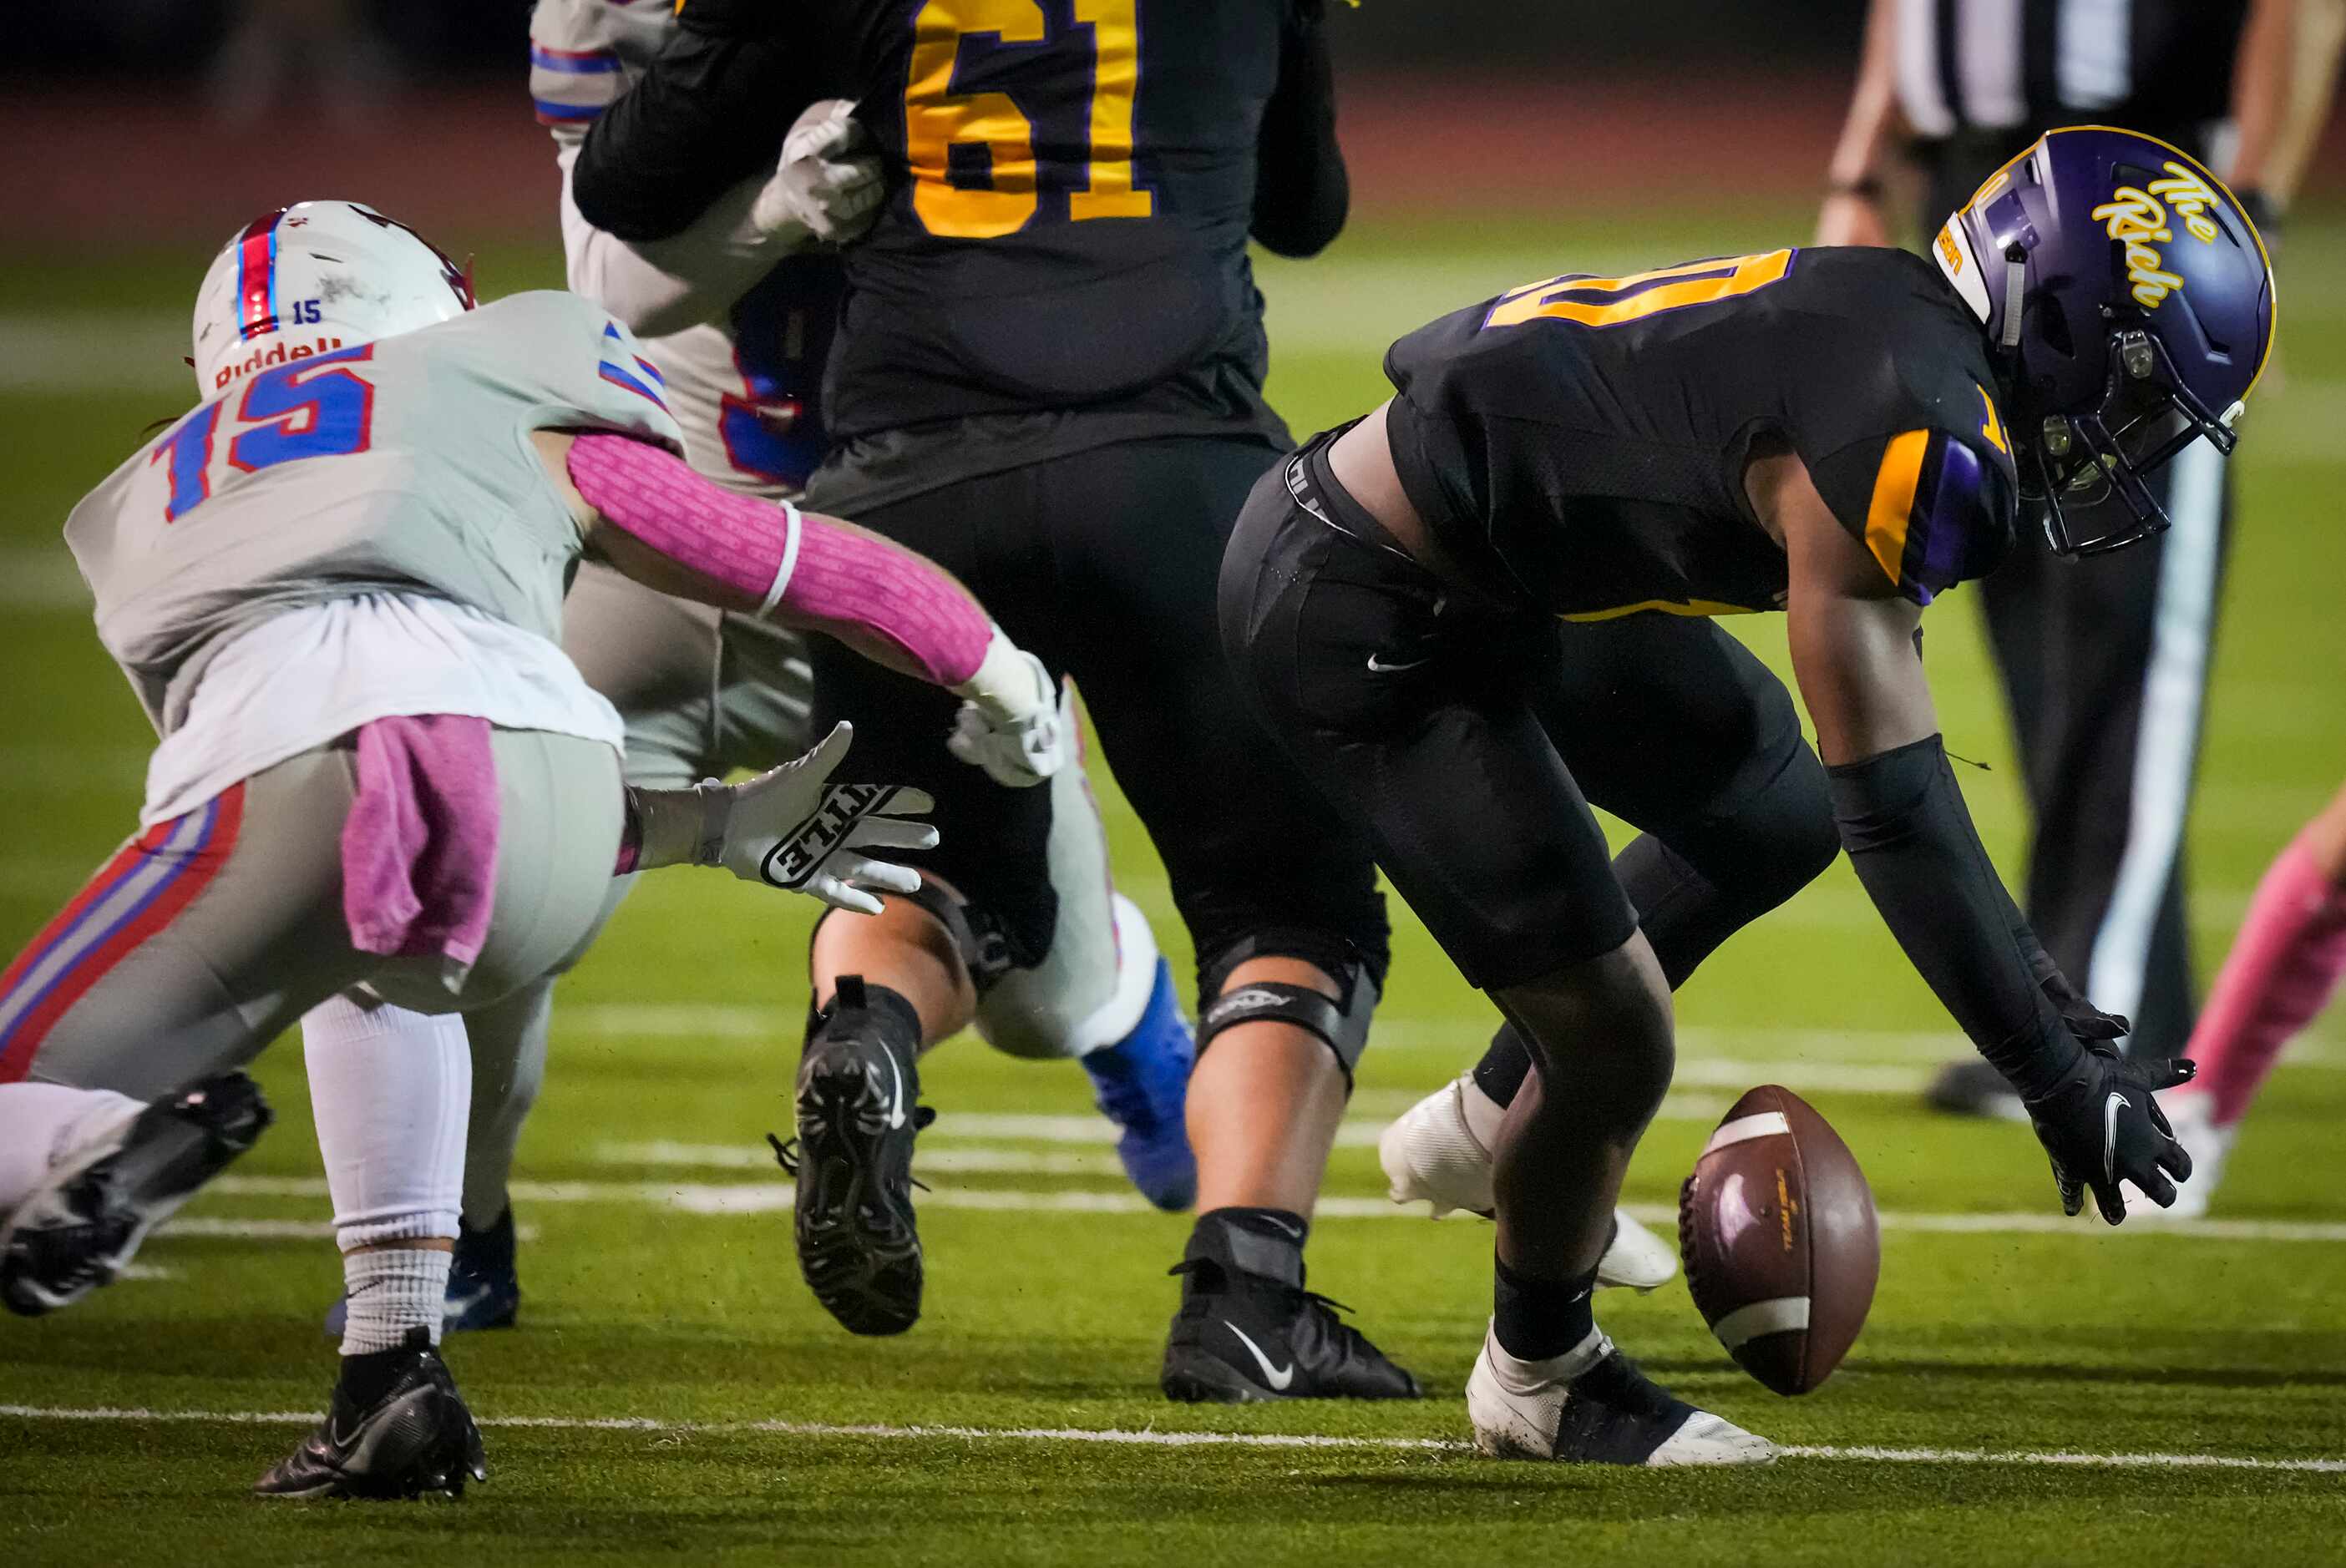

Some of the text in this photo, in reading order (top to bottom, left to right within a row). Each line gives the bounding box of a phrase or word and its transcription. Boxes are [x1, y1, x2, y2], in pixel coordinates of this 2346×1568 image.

[902, 0, 1154, 240] 61
[2091, 186, 2185, 309] Rich
[2148, 160, 2219, 245] The
[292, 299, 322, 325] 15
[215, 336, 342, 390] Riddell
[149, 341, 375, 524] 15
[776, 782, 882, 878] TTLE
